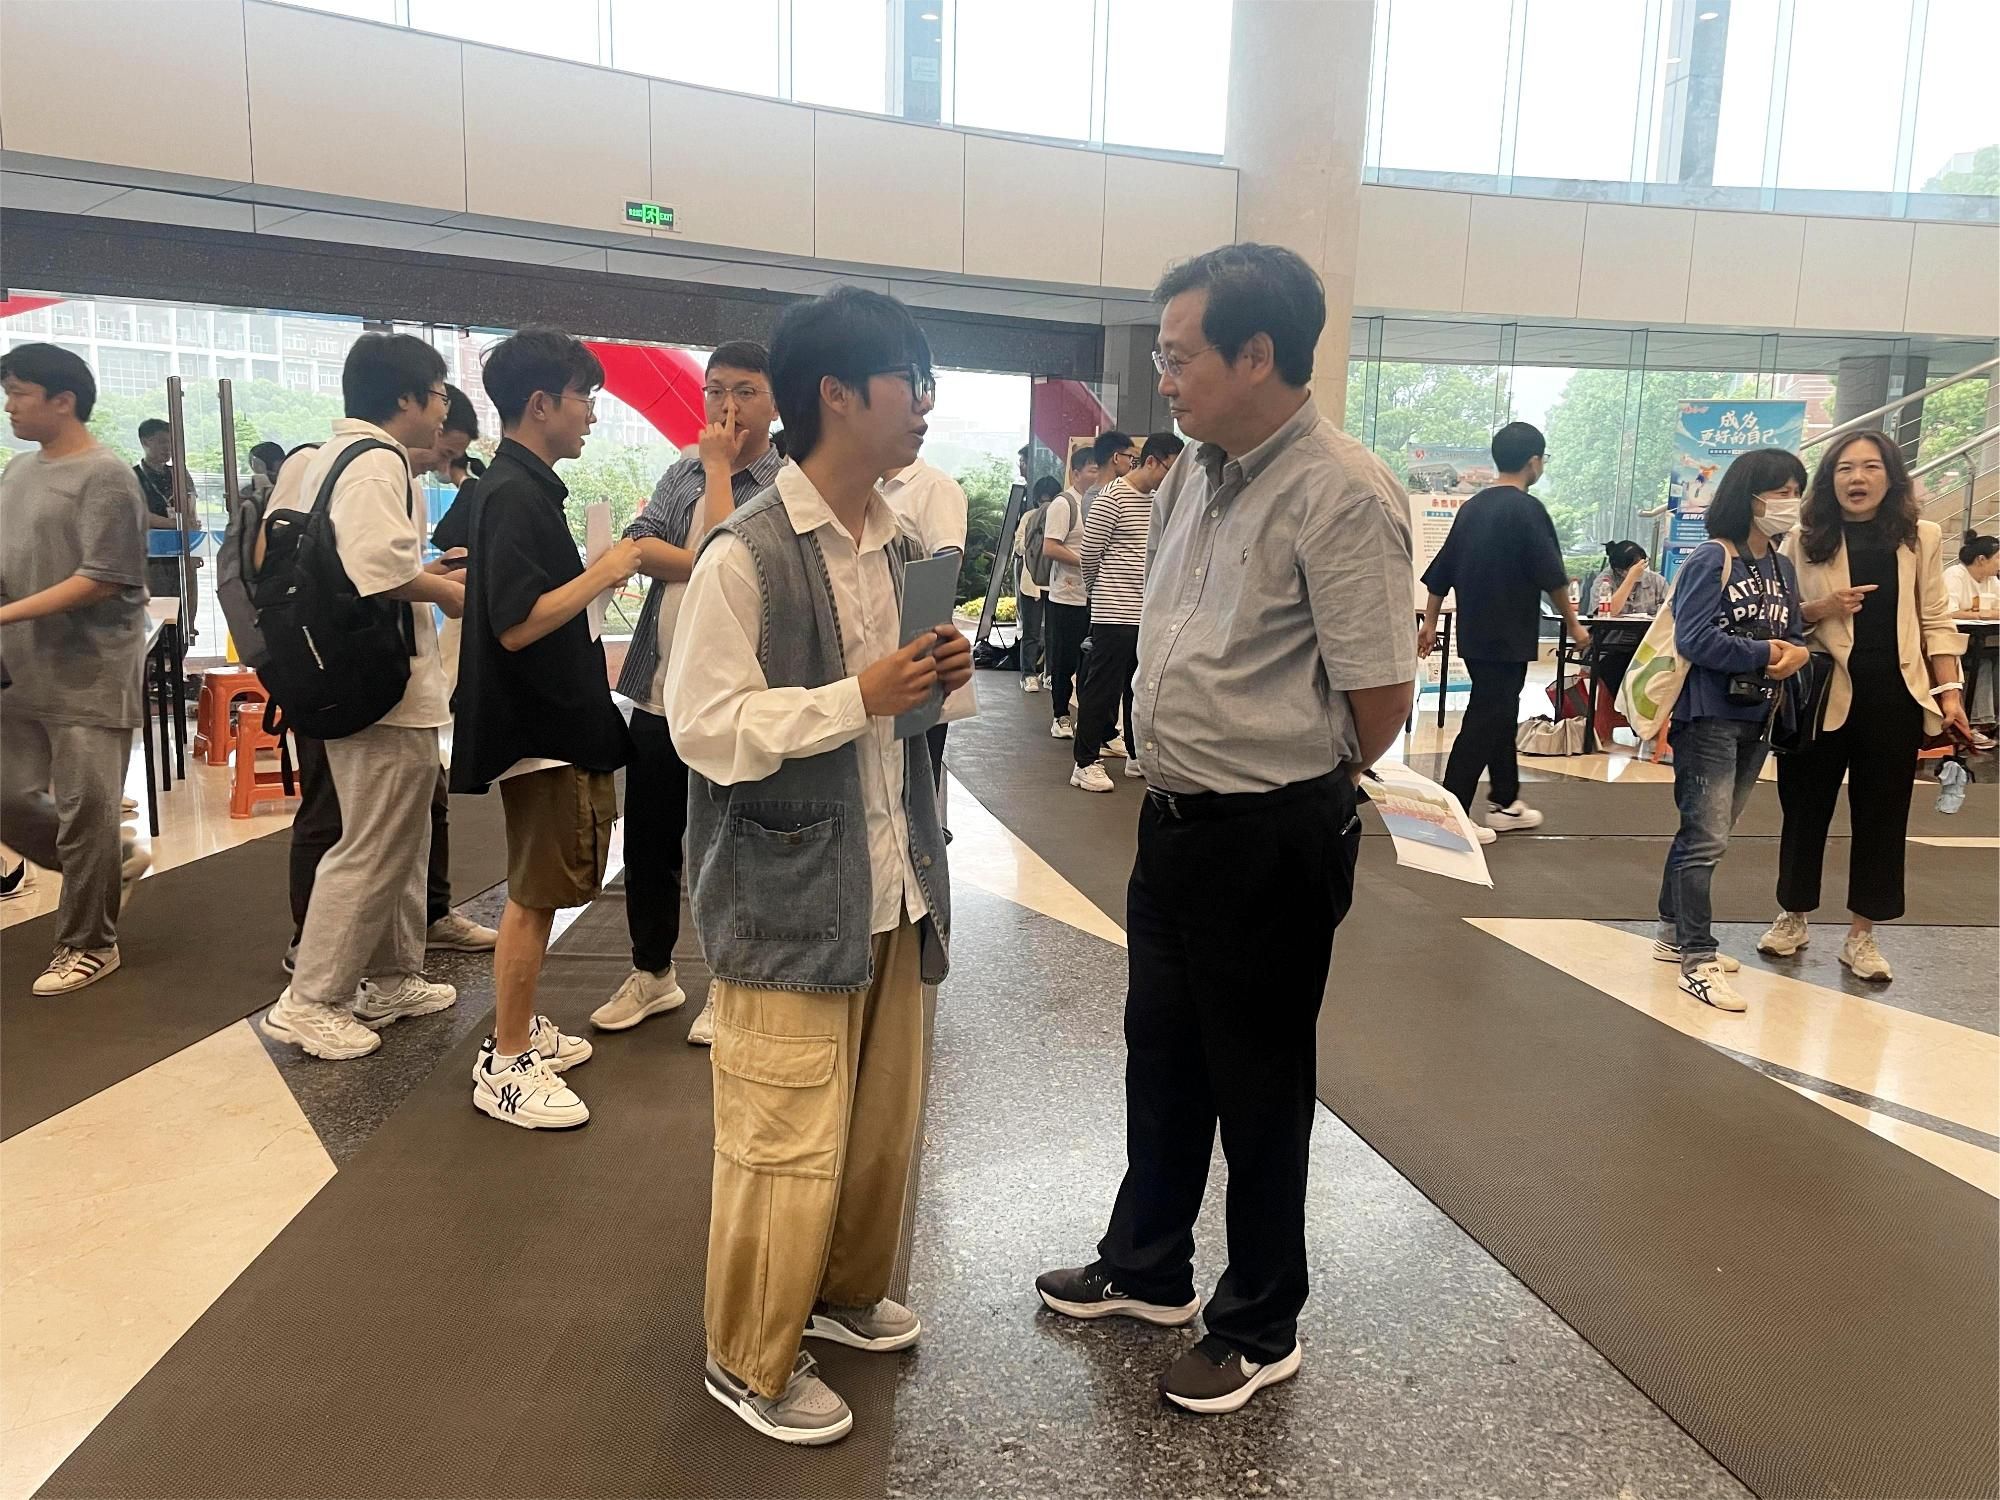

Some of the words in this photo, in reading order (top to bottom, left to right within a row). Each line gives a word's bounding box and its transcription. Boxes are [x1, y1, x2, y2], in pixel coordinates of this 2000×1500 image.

[1719, 409, 1758, 429] 成为
[1697, 426, 1779, 447] 更好的自己
